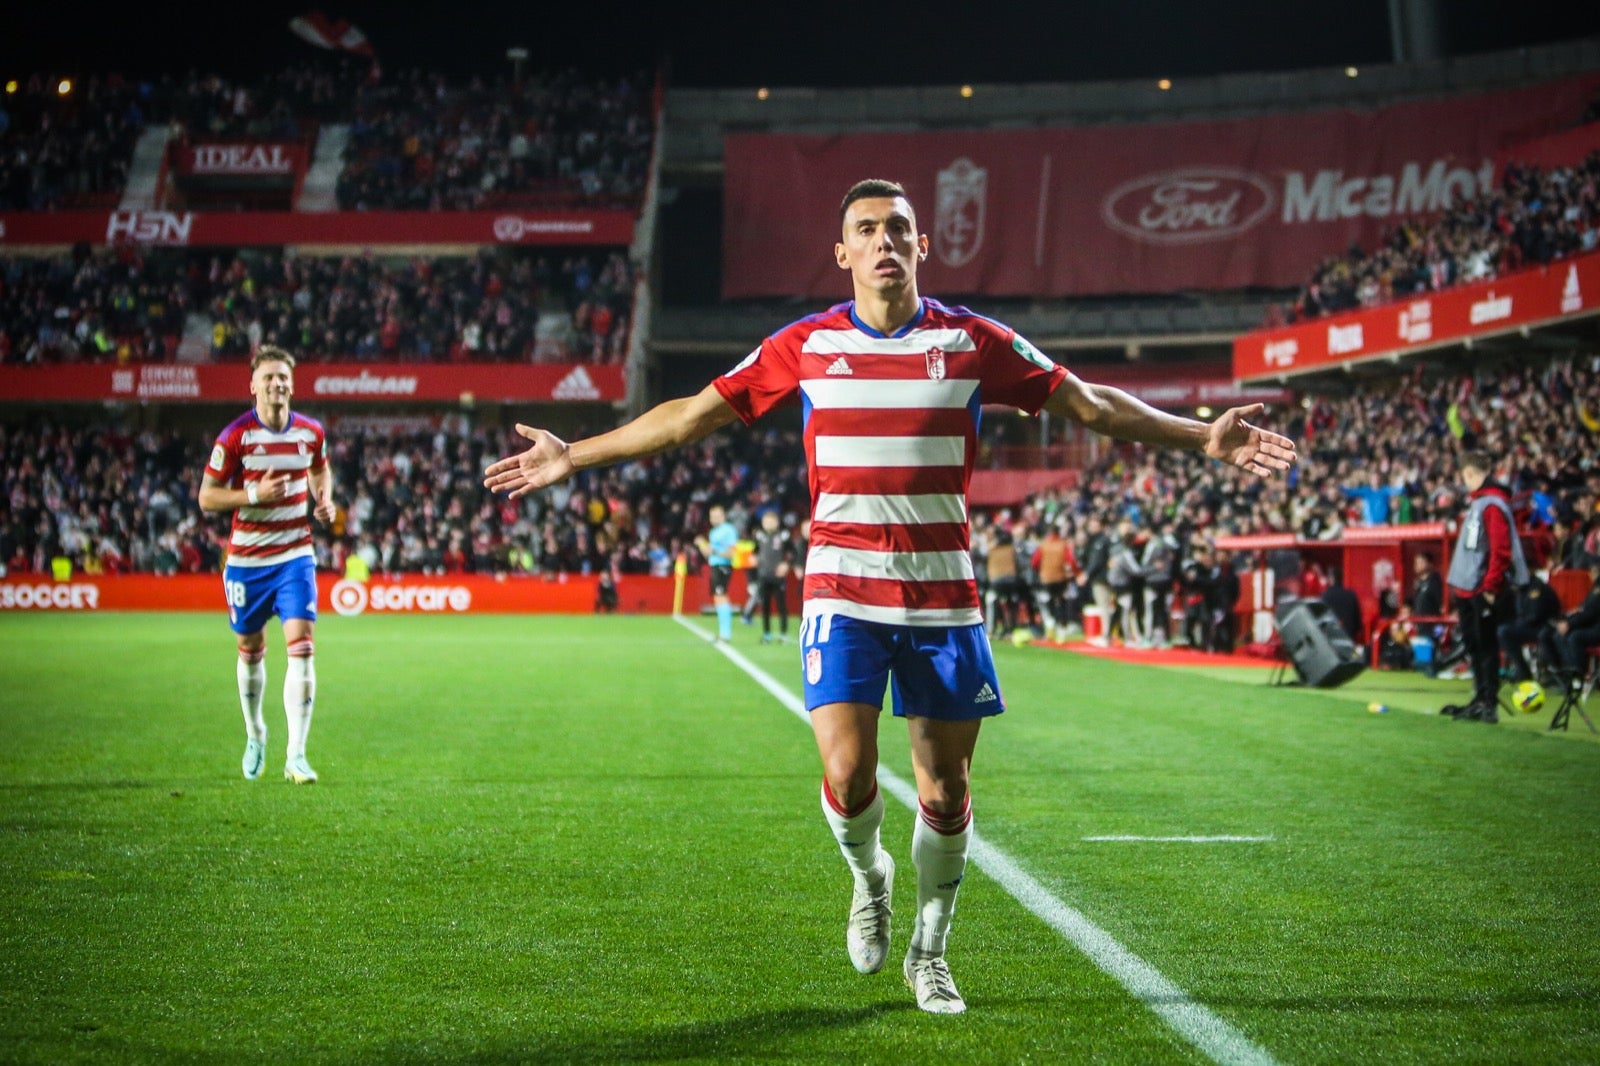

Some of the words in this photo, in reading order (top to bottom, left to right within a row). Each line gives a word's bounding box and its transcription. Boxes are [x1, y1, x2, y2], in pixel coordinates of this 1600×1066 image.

[193, 145, 291, 172] IDEAL
[1138, 179, 1242, 230] Ford
[105, 211, 193, 244] HSN
[825, 368, 853, 376] adidas
[226, 581, 246, 608] 18
[370, 585, 472, 611] sorare
